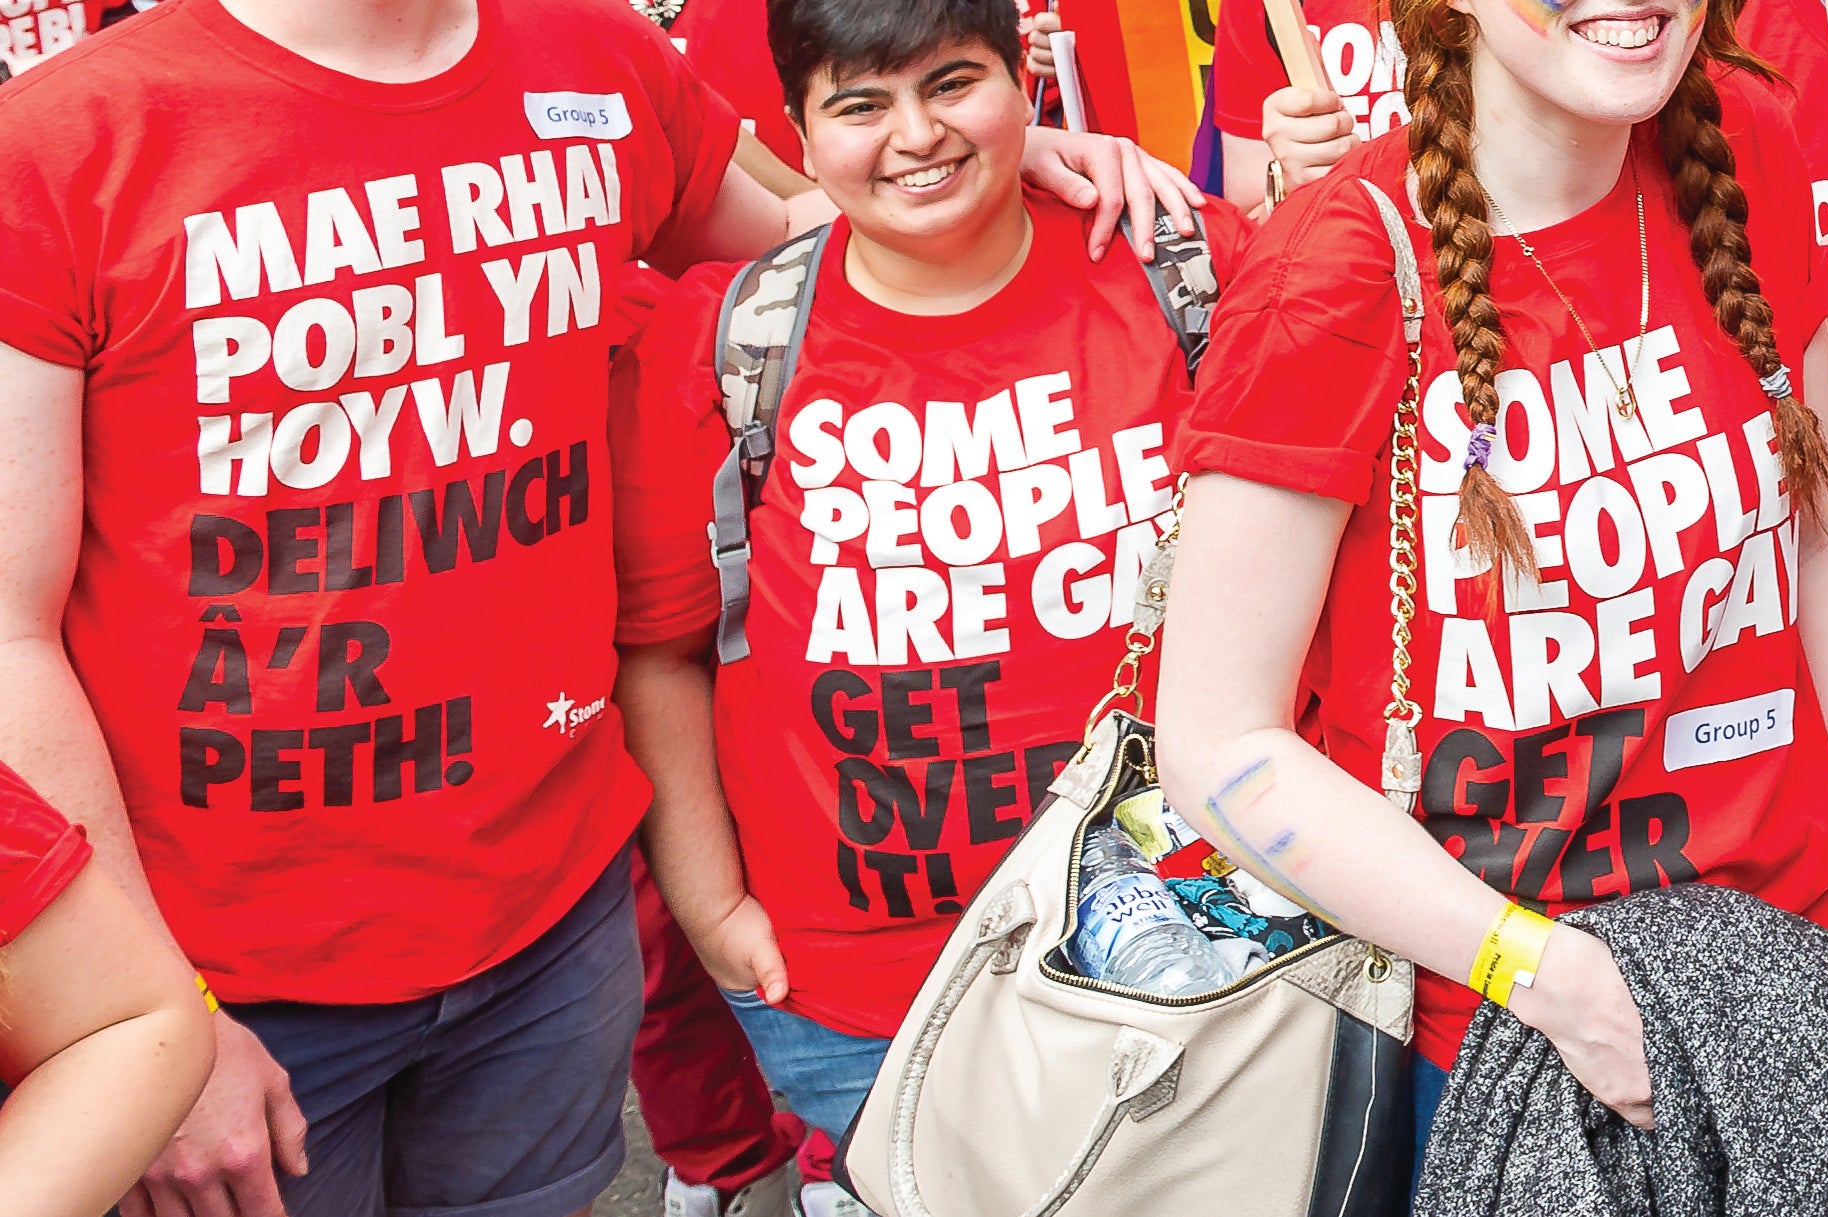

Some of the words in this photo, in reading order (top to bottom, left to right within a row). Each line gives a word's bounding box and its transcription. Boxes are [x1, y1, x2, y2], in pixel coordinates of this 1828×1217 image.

[547, 105, 595, 128] Group
[599, 109, 609, 125] 5
[184, 173, 424, 310] MAE
[191, 271, 465, 405] POBL
[481, 242, 600, 347] YN
[198, 361, 533, 497] HOYW.
[789, 370, 1080, 487] SOME
[1420, 324, 1706, 497] SOME
[187, 440, 589, 598] DELIWCH
[801, 422, 1173, 568] PEOPLE
[1422, 411, 1793, 615] PEOPLE
[805, 562, 1010, 666] ARE
[1433, 587, 1661, 732] ARE
[179, 695, 475, 812] PETH!
[811, 660, 1001, 761] GET
[1422, 707, 1647, 825] GET
[1695, 713, 1761, 747] Group
[1765, 710, 1777, 730] 5
[834, 740, 1085, 850] OVER
[838, 843, 965, 918] IT!
[1111, 900, 1168, 922] well
